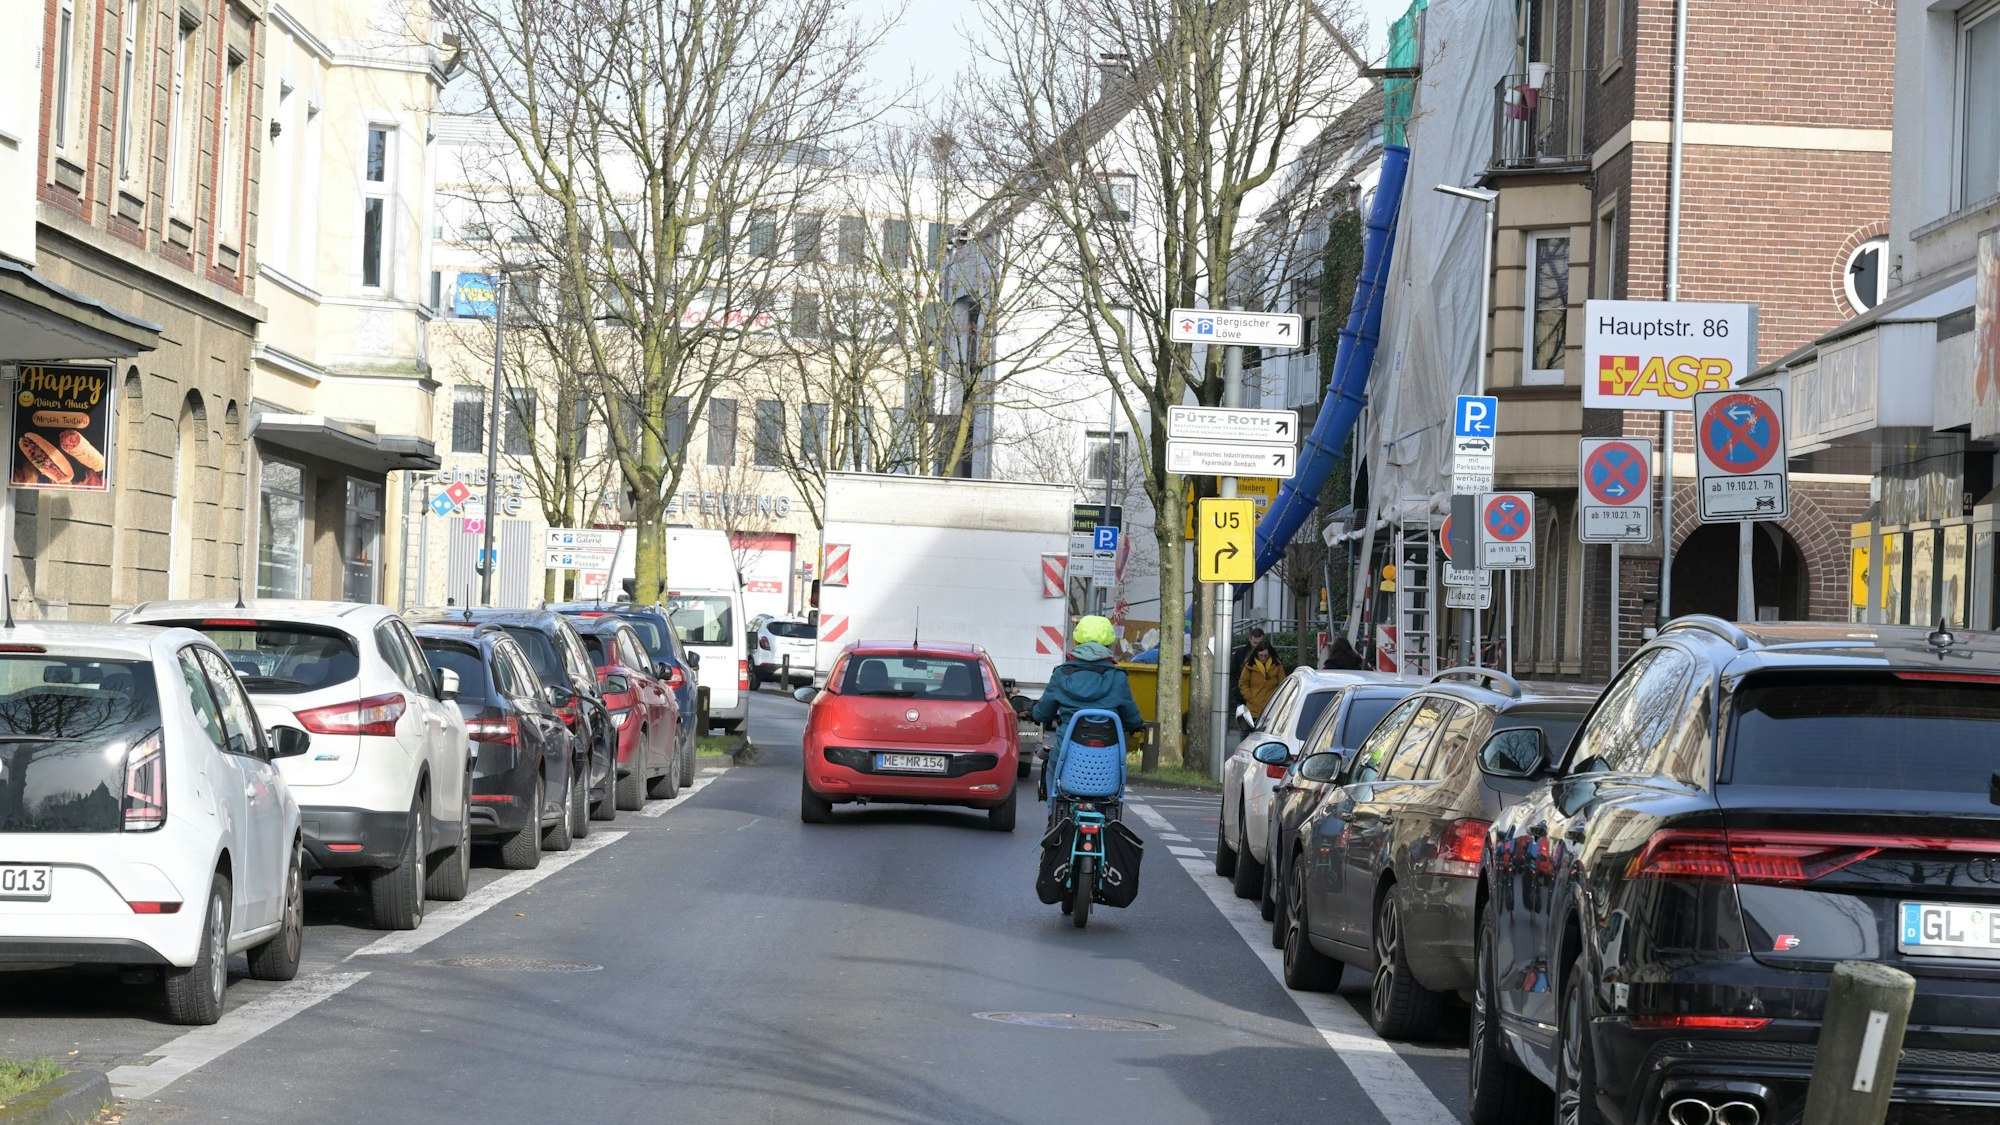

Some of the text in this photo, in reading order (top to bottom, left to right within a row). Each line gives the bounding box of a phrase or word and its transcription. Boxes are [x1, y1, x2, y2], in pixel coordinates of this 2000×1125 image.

[1216, 316, 1270, 328] Bergischer
[1599, 316, 1729, 340] Hauptstr. 86
[1216, 328, 1242, 339] Löwe
[1628, 355, 1733, 400] ASB
[21, 366, 105, 405] Happy
[65, 398, 90, 410] Haus
[1193, 450, 1266, 460] Rheinisches Industriemuseum
[1202, 458, 1232, 467] Papiermühle
[1456, 463, 1491, 471] Parkschein
[1455, 475, 1490, 484] werktags
[1238, 484, 1266, 494] ltenberg
[1711, 480, 1774, 492] ab 19.10.21. 7h
[1214, 511, 1240, 529] U5
[1591, 511, 1641, 520] ab 19.10.21. 7h
[884, 754, 944, 769] ME MR 154
[2, 869, 46, 891] 013
[1923, 909, 1965, 941] GL
